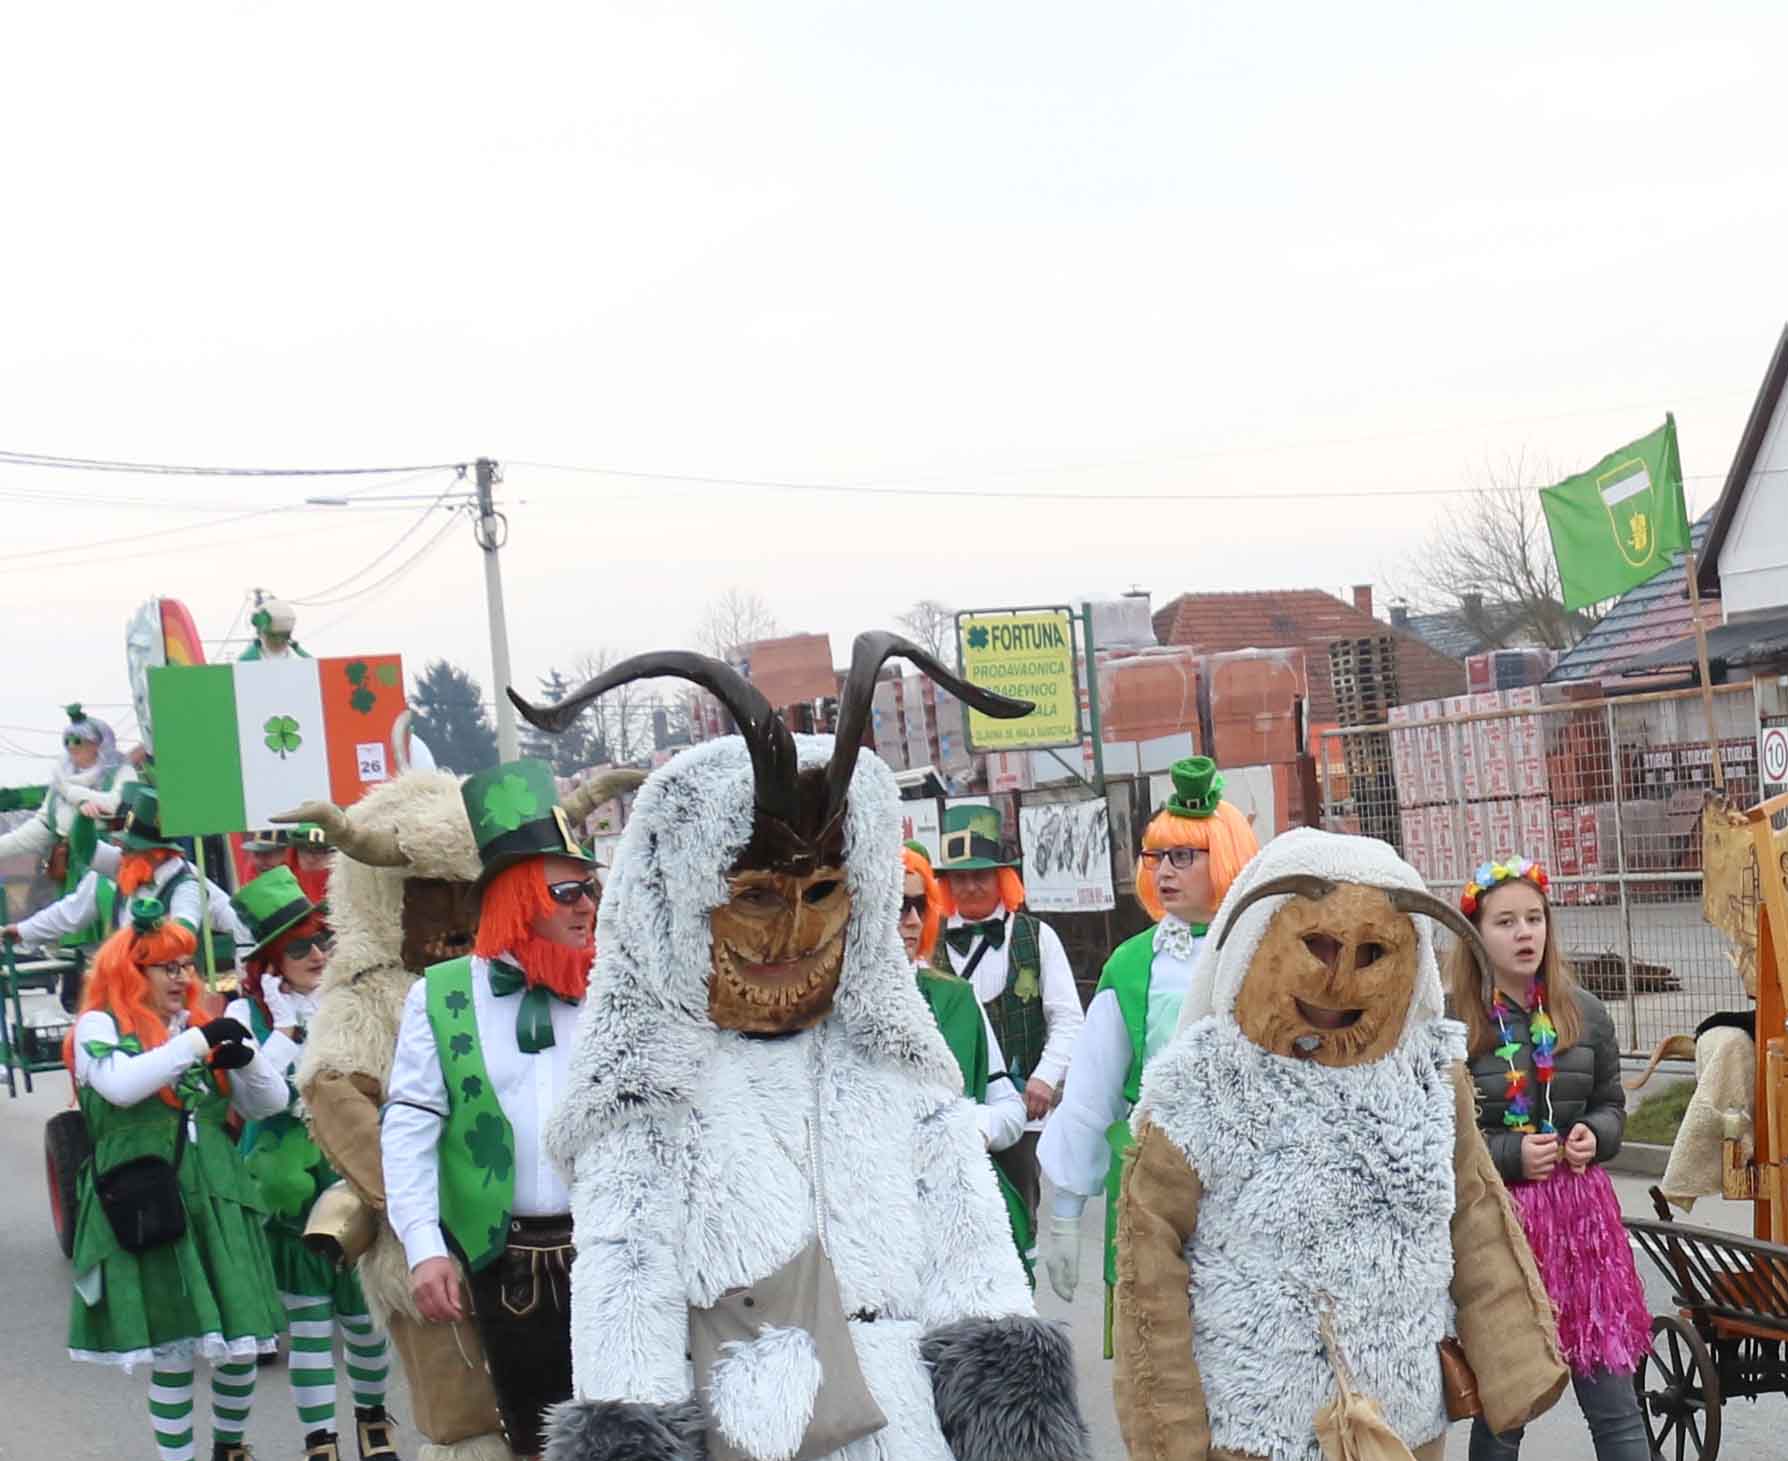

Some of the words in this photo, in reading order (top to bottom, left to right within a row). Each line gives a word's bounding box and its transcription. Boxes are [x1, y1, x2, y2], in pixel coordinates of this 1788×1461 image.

[991, 622, 1065, 651] FORTUNA
[973, 660, 1065, 681] PRODAVAONICA
[360, 760, 382, 773] 26
[1768, 743, 1785, 768] 10
